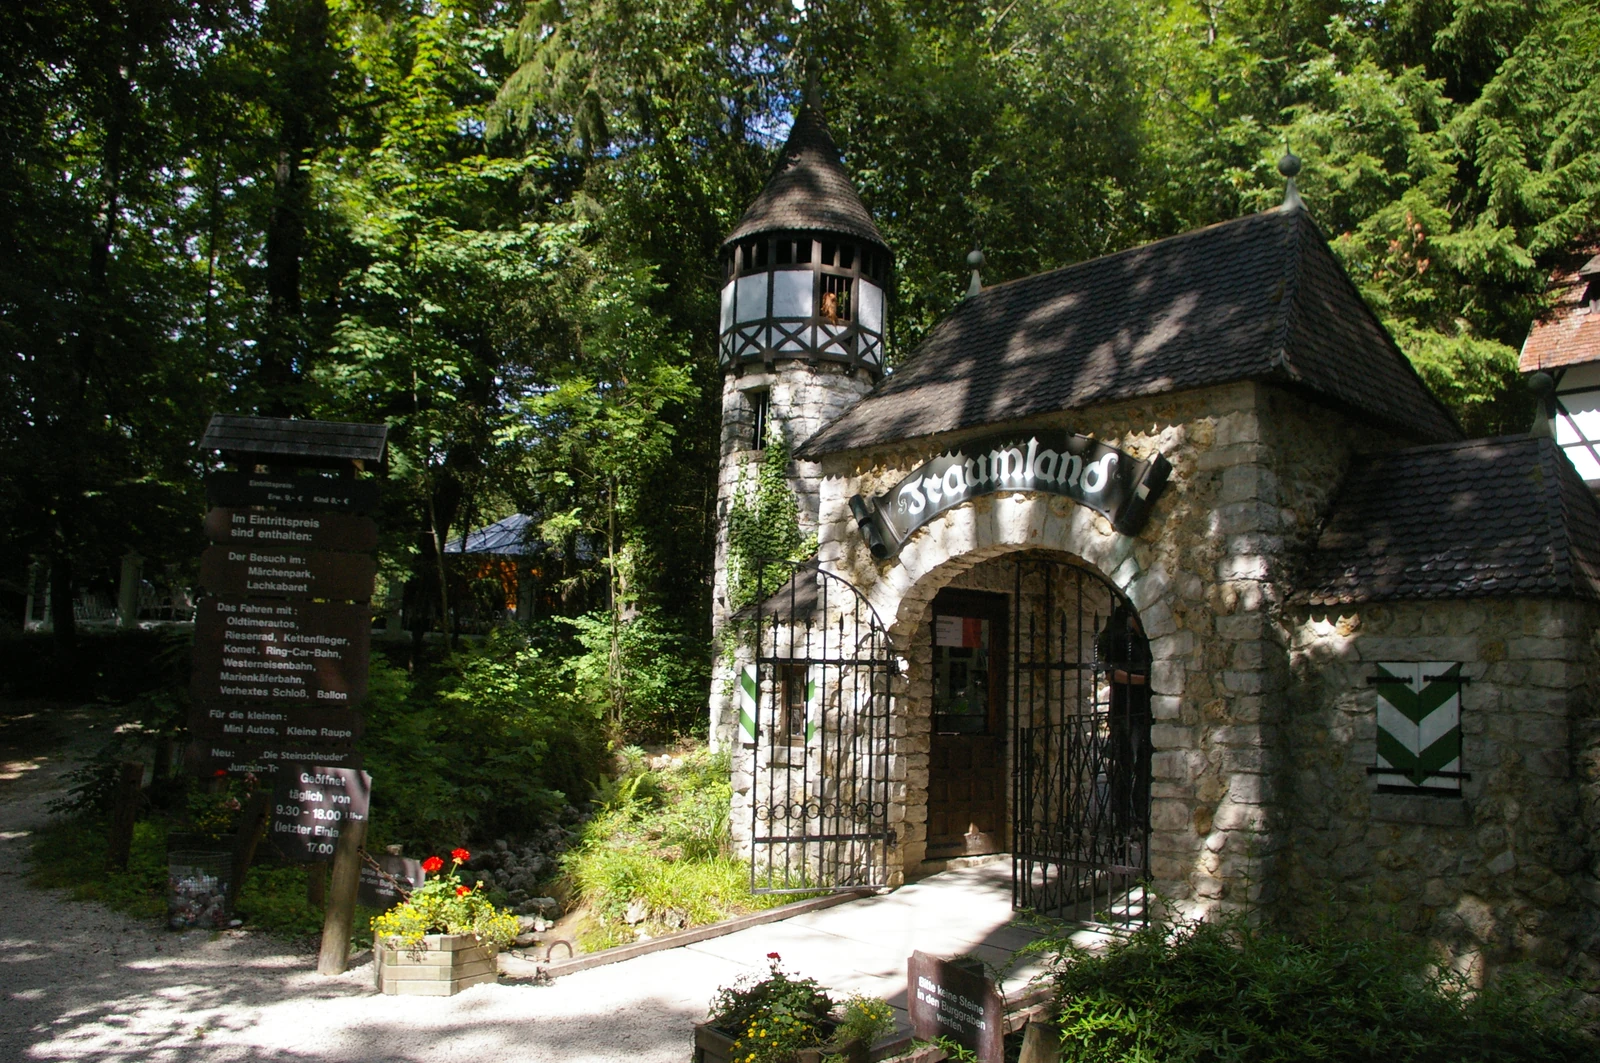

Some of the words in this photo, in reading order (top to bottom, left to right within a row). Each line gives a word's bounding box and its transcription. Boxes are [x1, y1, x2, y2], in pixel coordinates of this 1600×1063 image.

[897, 436, 1119, 514] Traumland
[313, 496, 329, 504] Kind
[232, 513, 245, 523] Im
[250, 514, 320, 528] Eintrittspreis
[231, 528, 254, 538] sind
[258, 529, 312, 541] enthalten:
[228, 552, 246, 561] Der
[250, 553, 286, 564] Besuch
[248, 567, 316, 579] Märchenpark,
[246, 581, 308, 592] Lachkabaret
[217, 602, 236, 612] Das
[240, 604, 273, 614] Fahren
[226, 616, 299, 630] Oldtimerautos,
[225, 631, 278, 642] Riesenrad,
[283, 633, 350, 646] Kettenflieger,
[223, 644, 261, 655] Komet,
[266, 646, 342, 660] Ring-Car-Bahn,
[223, 658, 317, 672] Westerneisenbahn,
[220, 672, 306, 685] Marienkäferbahn,
[220, 686, 268, 697] Verhextes
[317, 690, 347, 700] Ballon
[209, 709, 225, 719] Für
[229, 710, 244, 719] die
[224, 724, 243, 733] Mini
[247, 725, 279, 735] Autos,
[286, 727, 317, 736] Kleine
[321, 728, 352, 738] Raupe
[211, 749, 235, 758] Neu:
[300, 773, 346, 787] Geöffnet
[289, 789, 323, 803] täglich
[332, 794, 351, 804] von
[276, 805, 300, 816] 9.30
[312, 809, 342, 821] 18.00
[275, 822, 311, 835] (letzter
[307, 842, 334, 854] 17.00
[918, 976, 936, 993] Bitte
[937, 984, 957, 1003] keine
[959, 995, 984, 1015] Steine
[917, 988, 925, 1001] in
[925, 995, 940, 1008] den
[941, 1000, 986, 1031] Burggraben
[936, 1013, 965, 1034] werfen.
